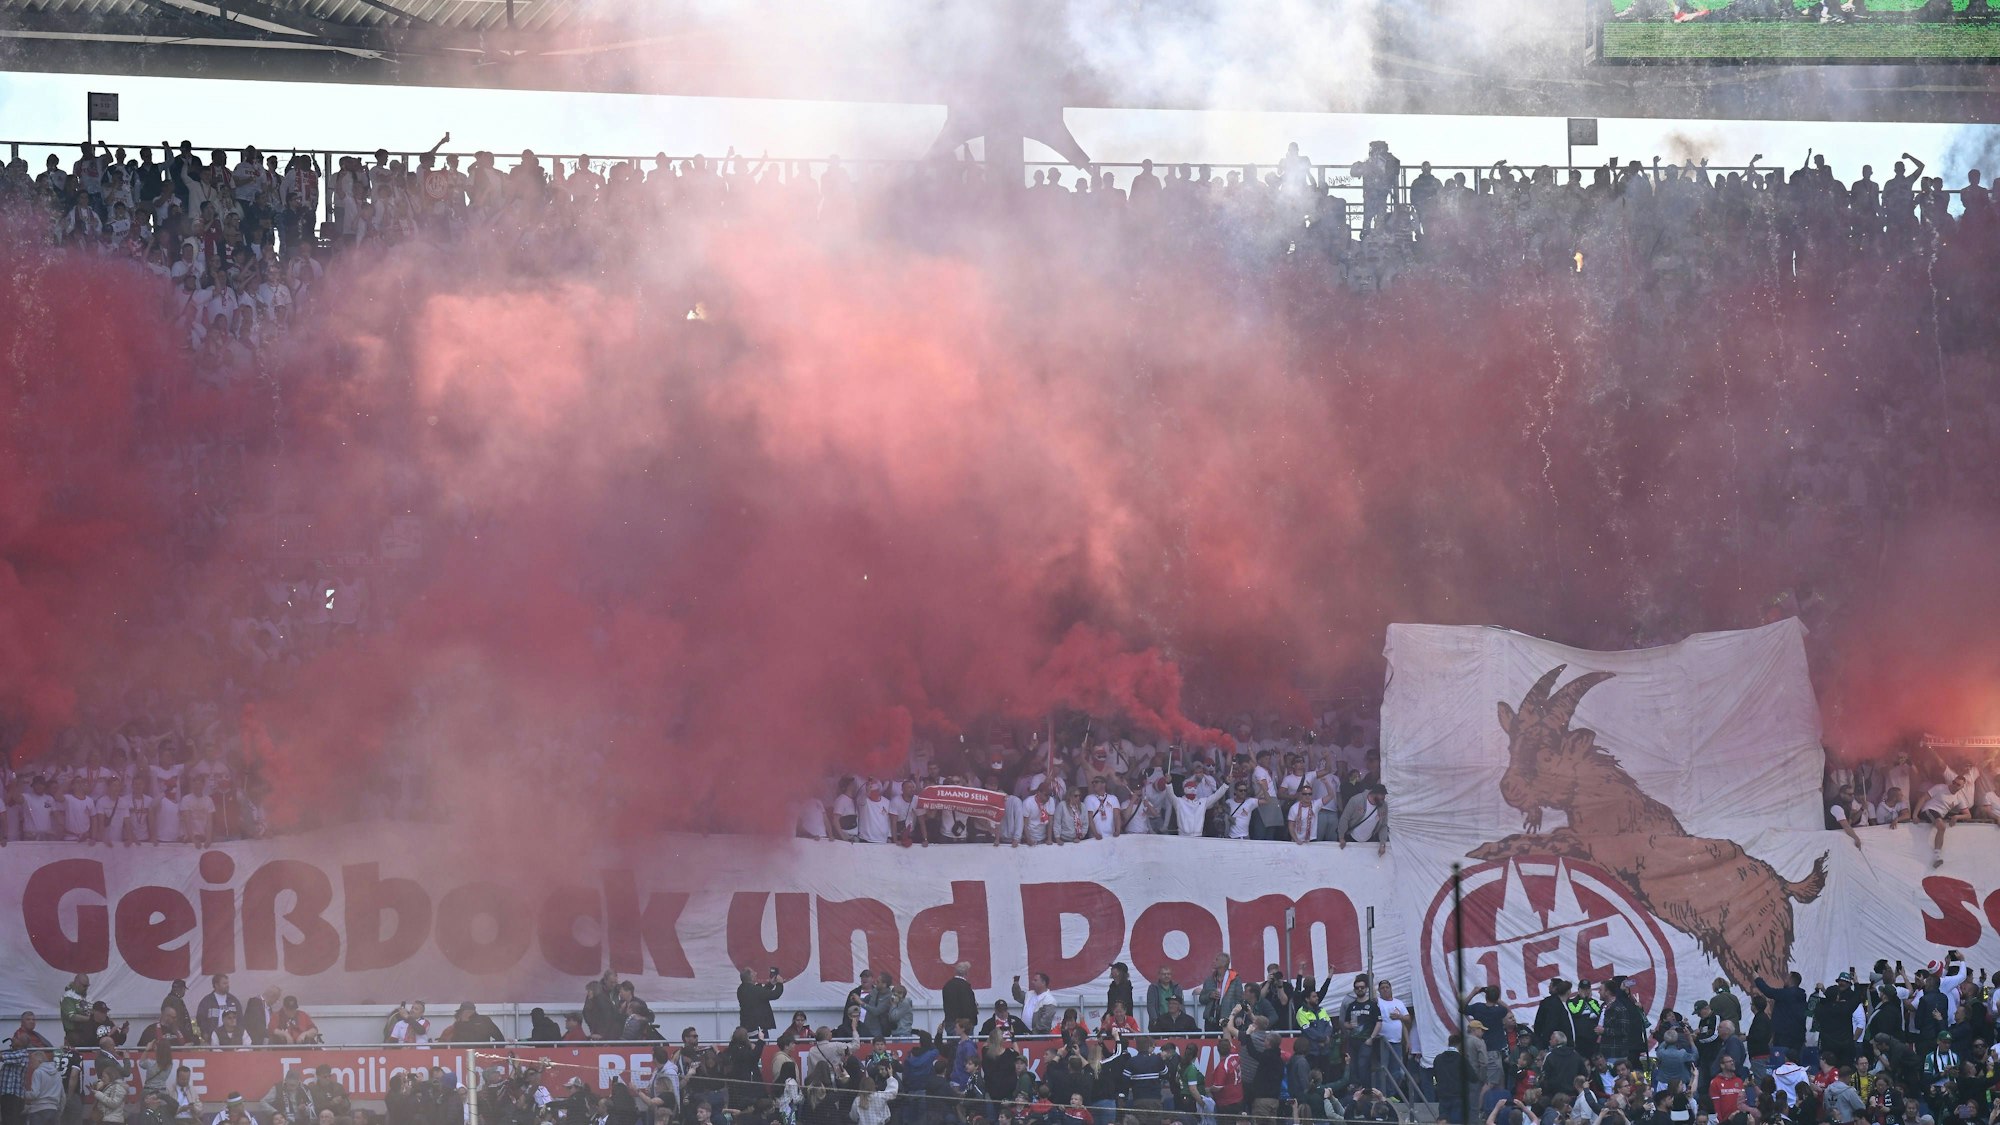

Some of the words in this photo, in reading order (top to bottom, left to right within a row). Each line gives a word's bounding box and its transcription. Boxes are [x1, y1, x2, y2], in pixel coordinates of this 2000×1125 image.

[937, 789, 970, 799] JEMAND
[971, 793, 989, 802] SEIN
[22, 850, 695, 981] Geißbock
[726, 880, 992, 990] und
[1020, 881, 1363, 990] Dom
[1920, 875, 2000, 949] s
